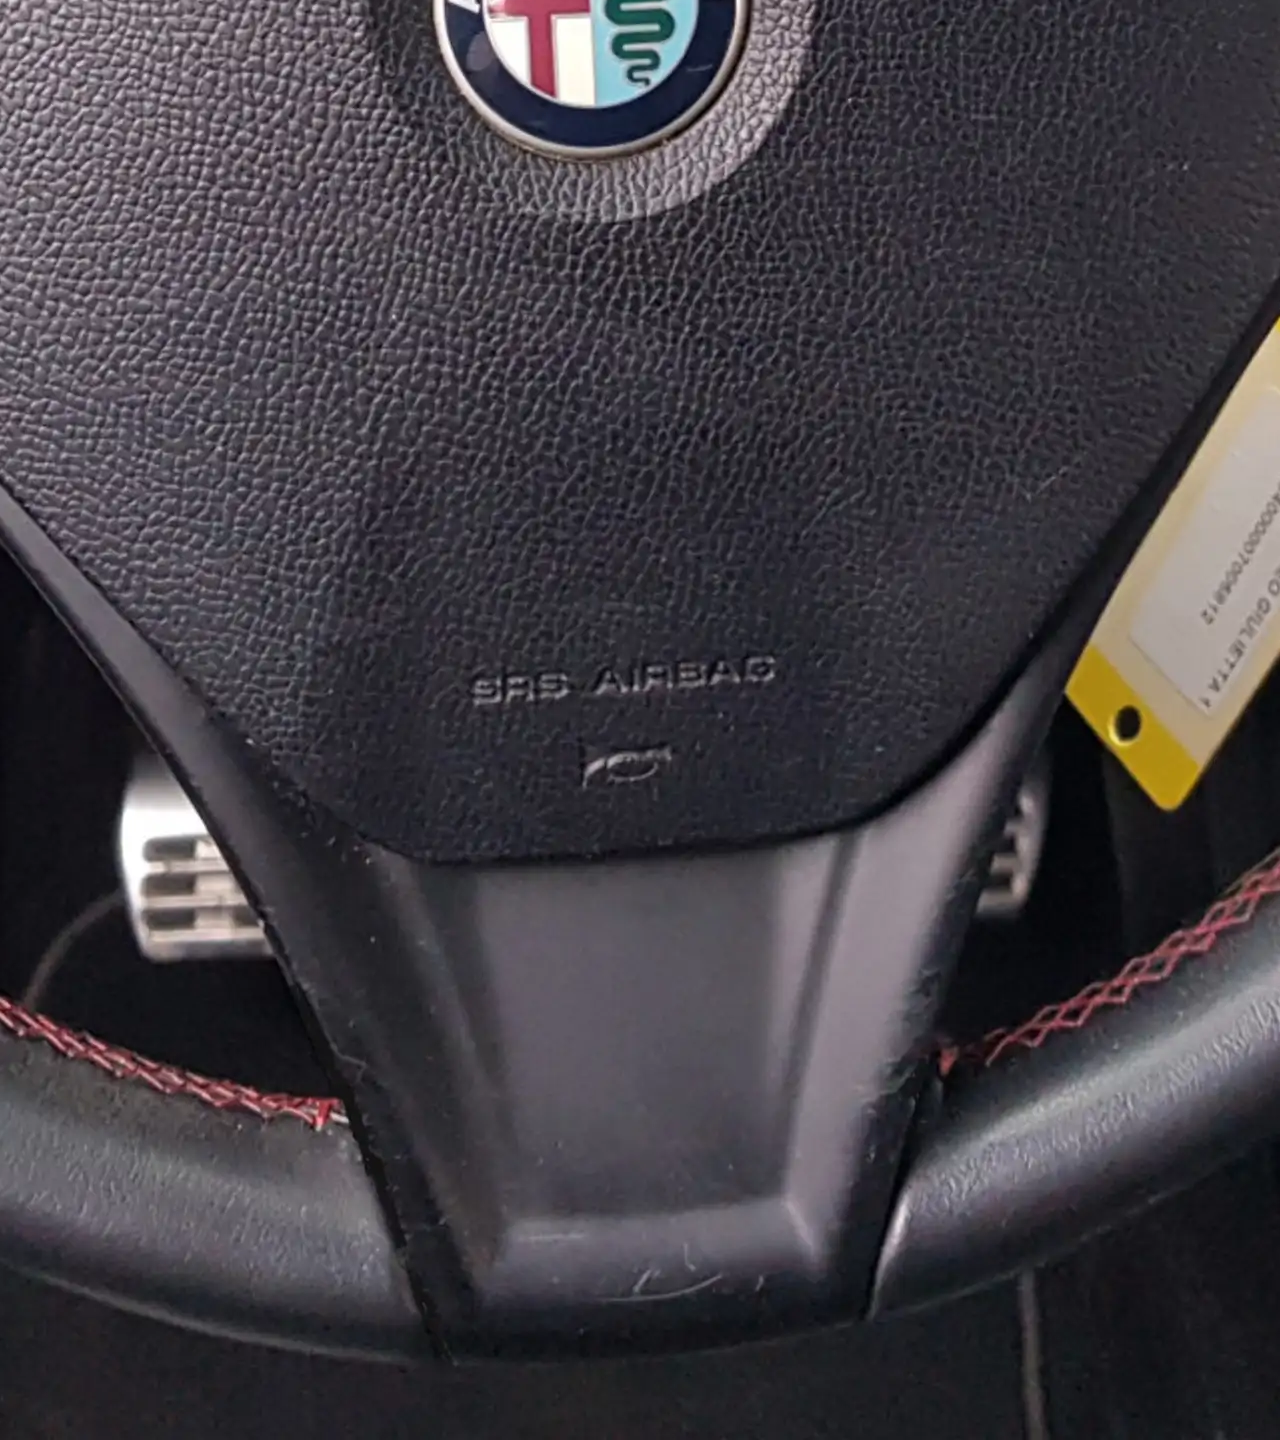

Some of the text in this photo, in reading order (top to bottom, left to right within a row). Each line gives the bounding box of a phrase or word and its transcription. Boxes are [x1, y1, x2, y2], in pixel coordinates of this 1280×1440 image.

[471, 654, 777, 707] SRS AIRBAG
[1208, 597, 1271, 694] GIULIETTA
